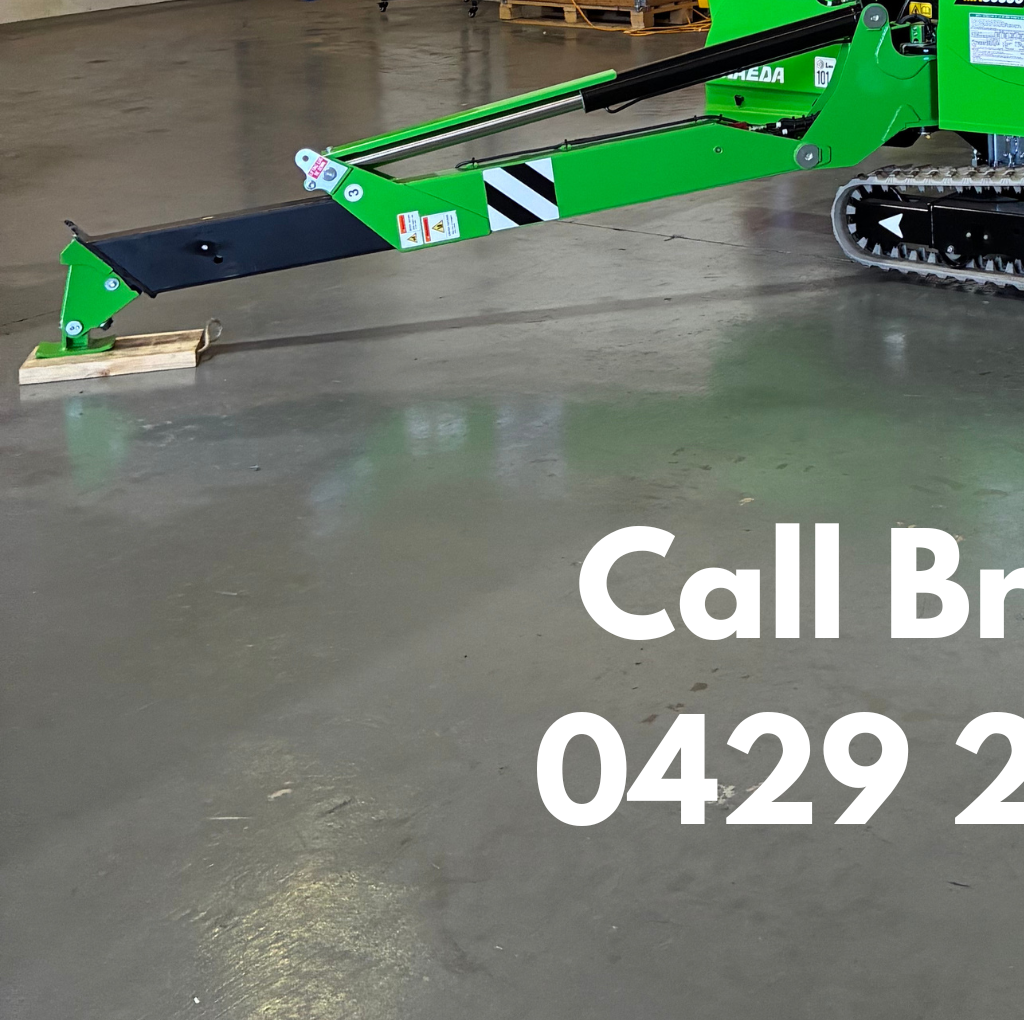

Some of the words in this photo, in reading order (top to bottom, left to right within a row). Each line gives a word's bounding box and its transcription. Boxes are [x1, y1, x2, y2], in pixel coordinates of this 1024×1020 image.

[722, 65, 784, 83] AEDA
[816, 70, 830, 85] 101
[348, 188, 359, 198] 3
